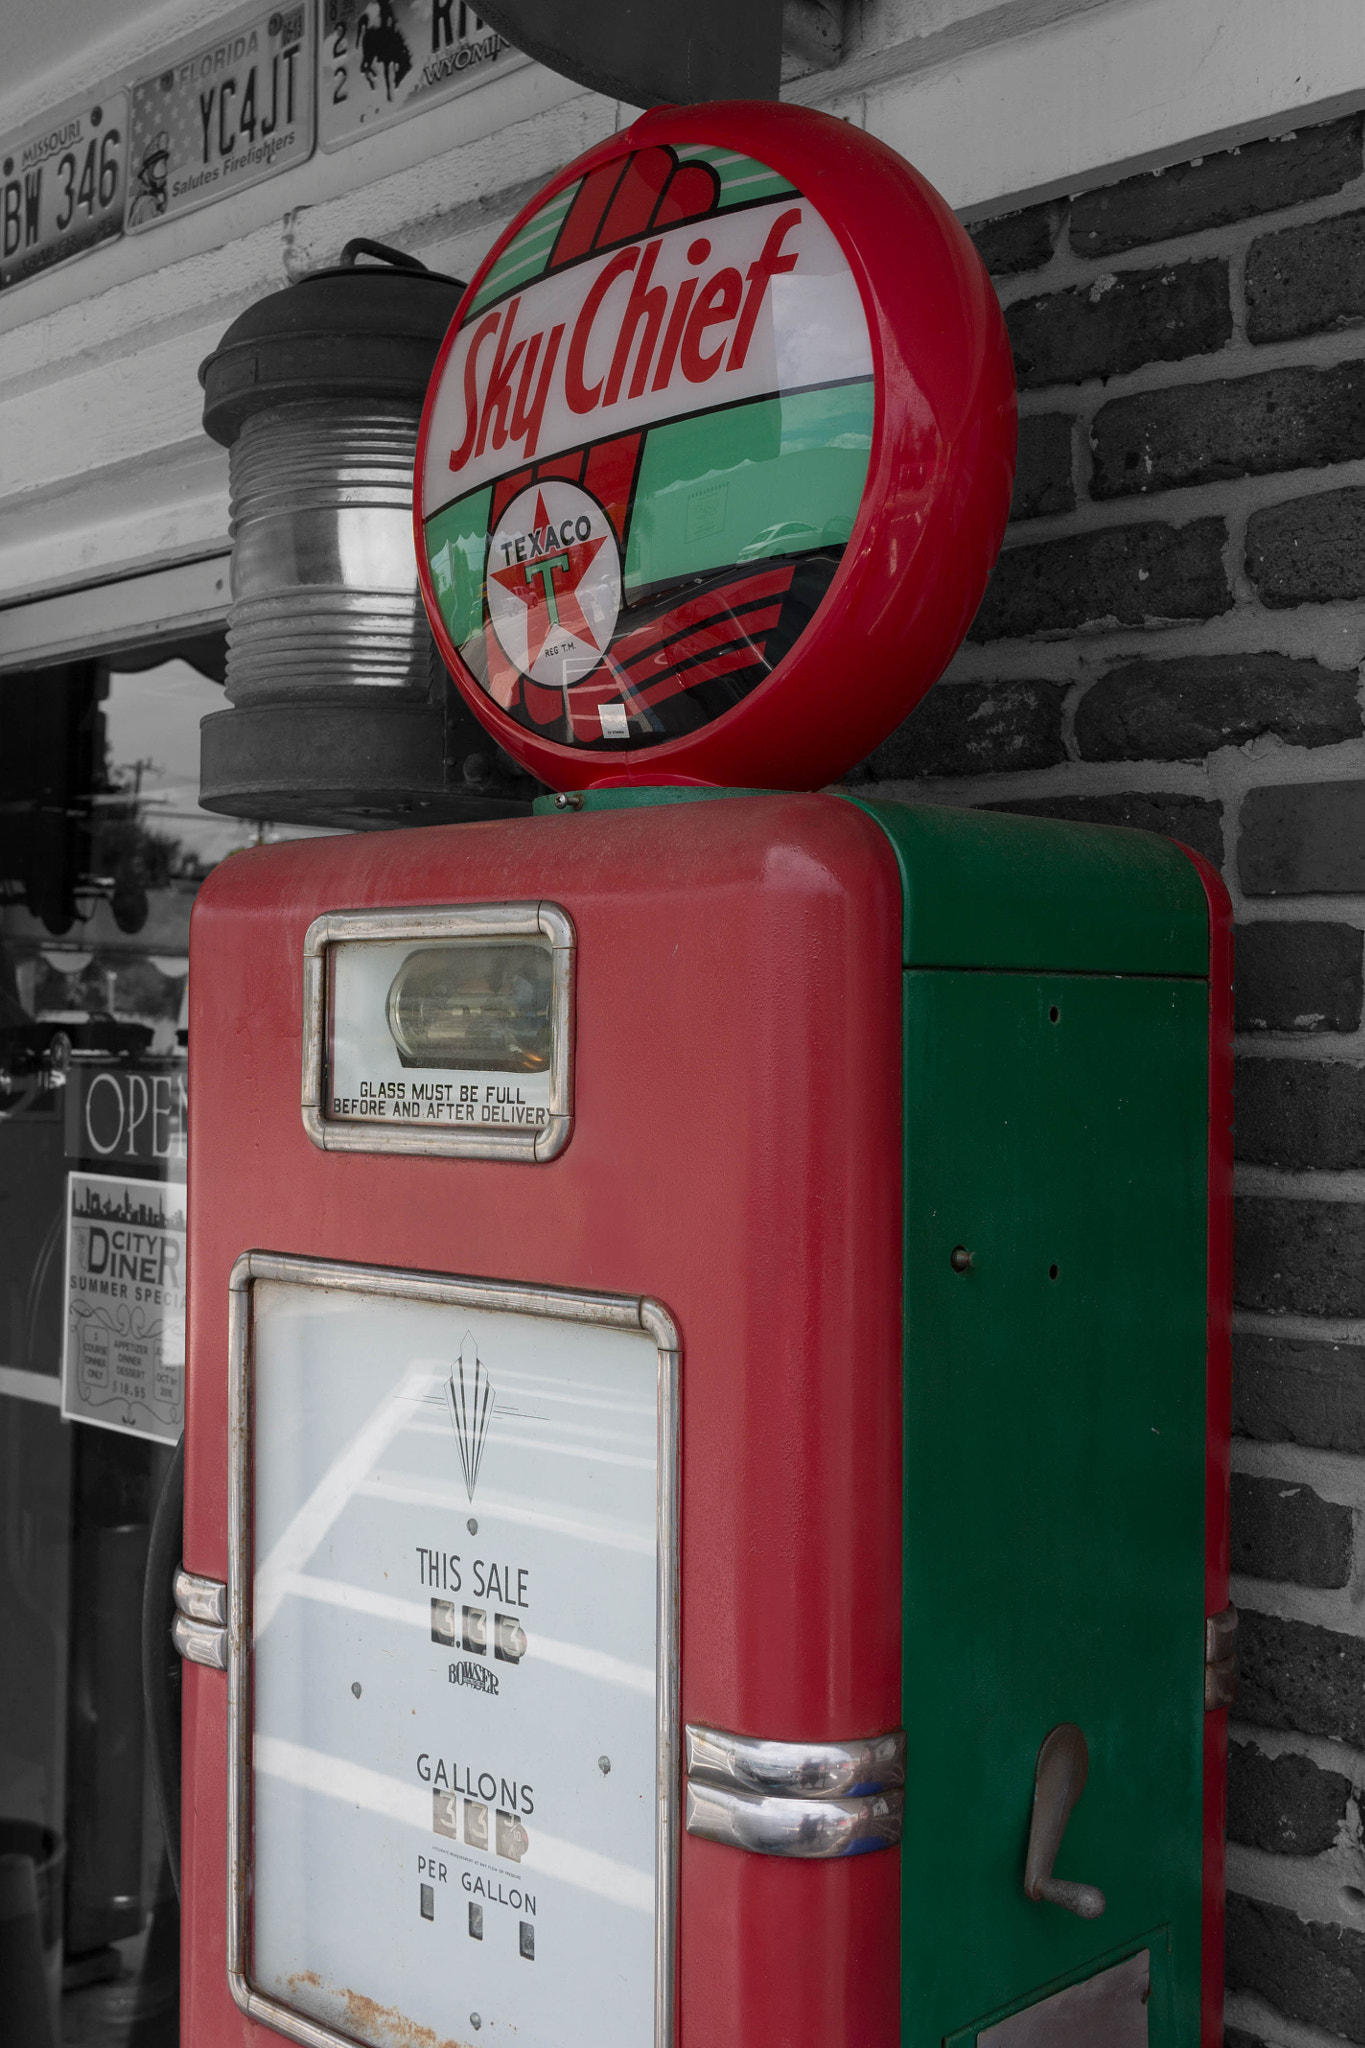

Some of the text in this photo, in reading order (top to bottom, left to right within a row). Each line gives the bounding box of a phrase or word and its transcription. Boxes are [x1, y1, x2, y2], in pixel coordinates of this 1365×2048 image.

[178, 30, 259, 91] FLORIDA
[199, 45, 301, 164] YC4JT
[21, 119, 81, 167] MISSOURI
[171, 131, 296, 198] Salutes Firefighters
[0, 166, 42, 258] BW
[56, 128, 121, 231] 346
[448, 207, 802, 472] Sky Chief
[500, 515, 592, 567] TEXACO
[524, 553, 570, 626] T
[544, 645, 559, 658] REG
[333, 1098, 386, 1116] BEFORE
[392, 1101, 420, 1118] AND
[426, 1103, 475, 1121] AFTER
[360, 1081, 526, 1105] GLASS MUST BE FULL
[87, 1226, 180, 1289] DINER
[111, 1230, 158, 1255] CITY
[70, 1274, 128, 1300] SUMMER
[84, 1355, 106, 1367] DINNER
[114, 1340, 148, 1355] APPETIZER
[118, 1353, 142, 1367] DINNER
[87, 1368, 103, 1380] ONLY
[116, 1366, 145, 1380] DESSERT
[416, 1547, 529, 1608] THIS SALE
[448, 1661, 500, 1696] BOWSER
[416, 1753, 535, 1815] GALLONS
[417, 1855, 537, 1916] PER GALLON
